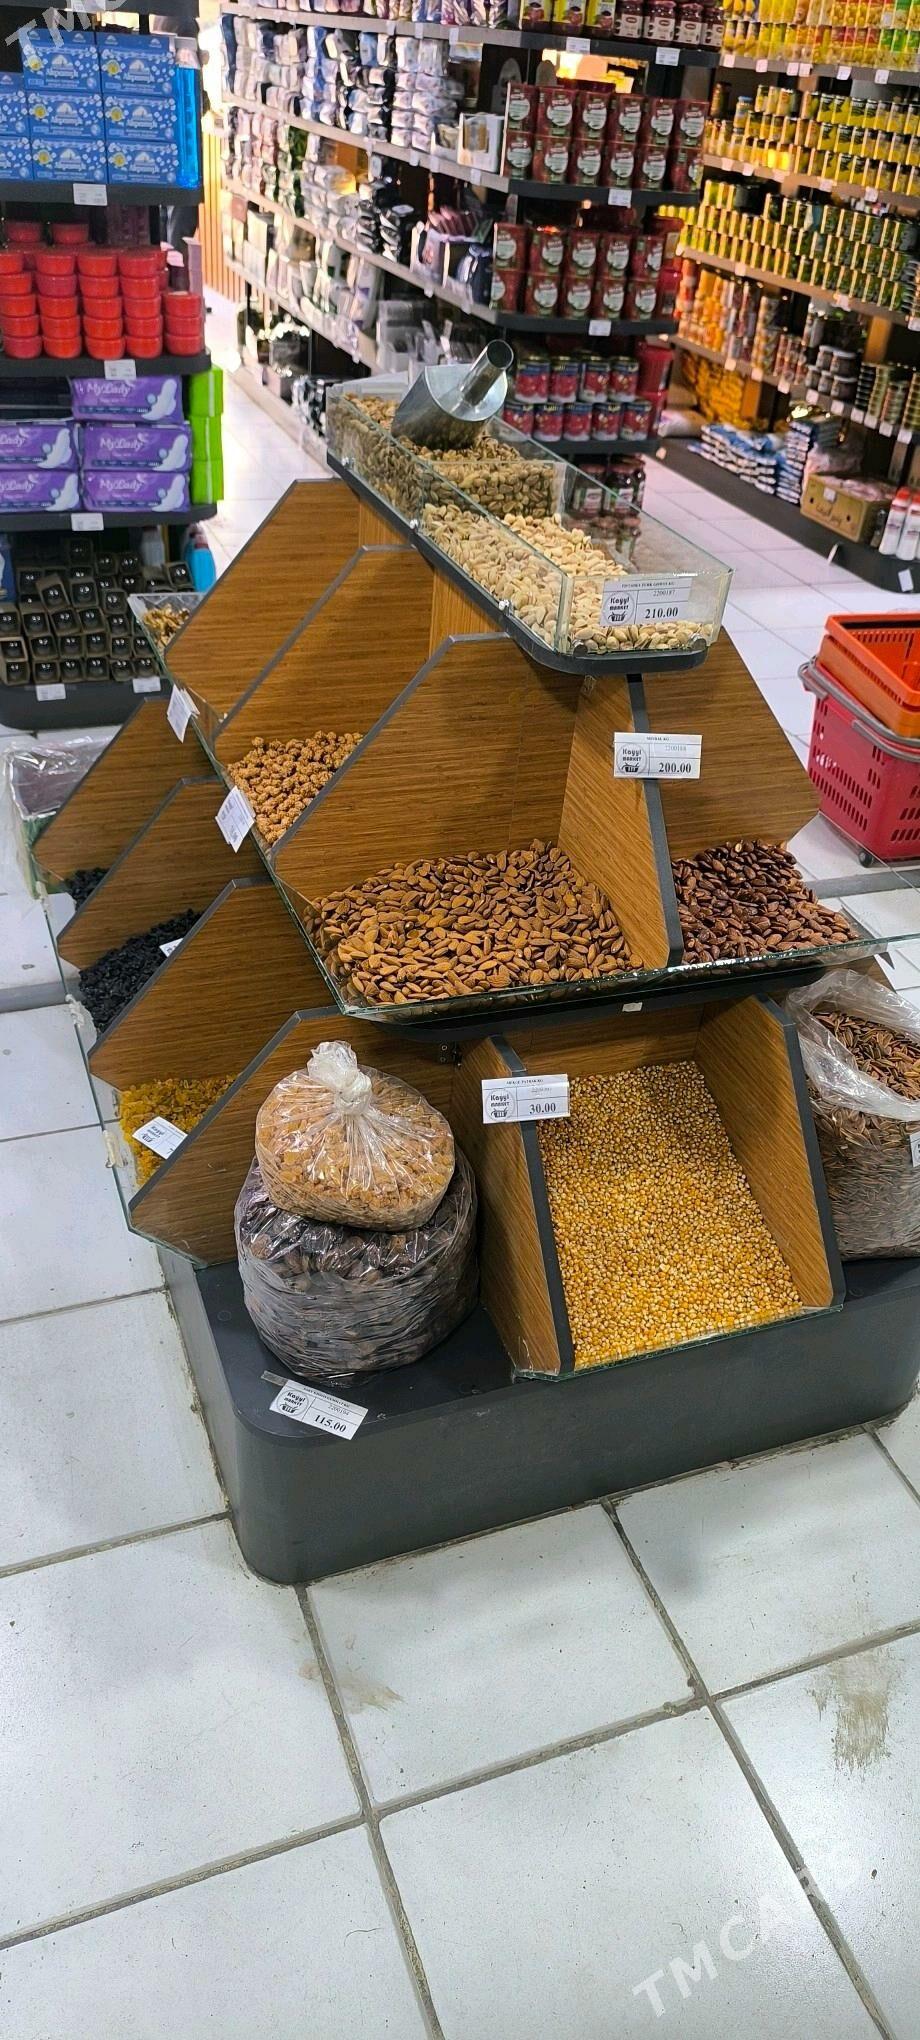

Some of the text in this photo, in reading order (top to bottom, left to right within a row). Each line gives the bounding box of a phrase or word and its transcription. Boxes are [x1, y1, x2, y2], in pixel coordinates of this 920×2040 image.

[645, 606, 679, 619] 210.00
[659, 762, 692, 774] 200.00
[529, 1102, 557, 1115] 30.00
[314, 1414, 347, 1433] 115.00
